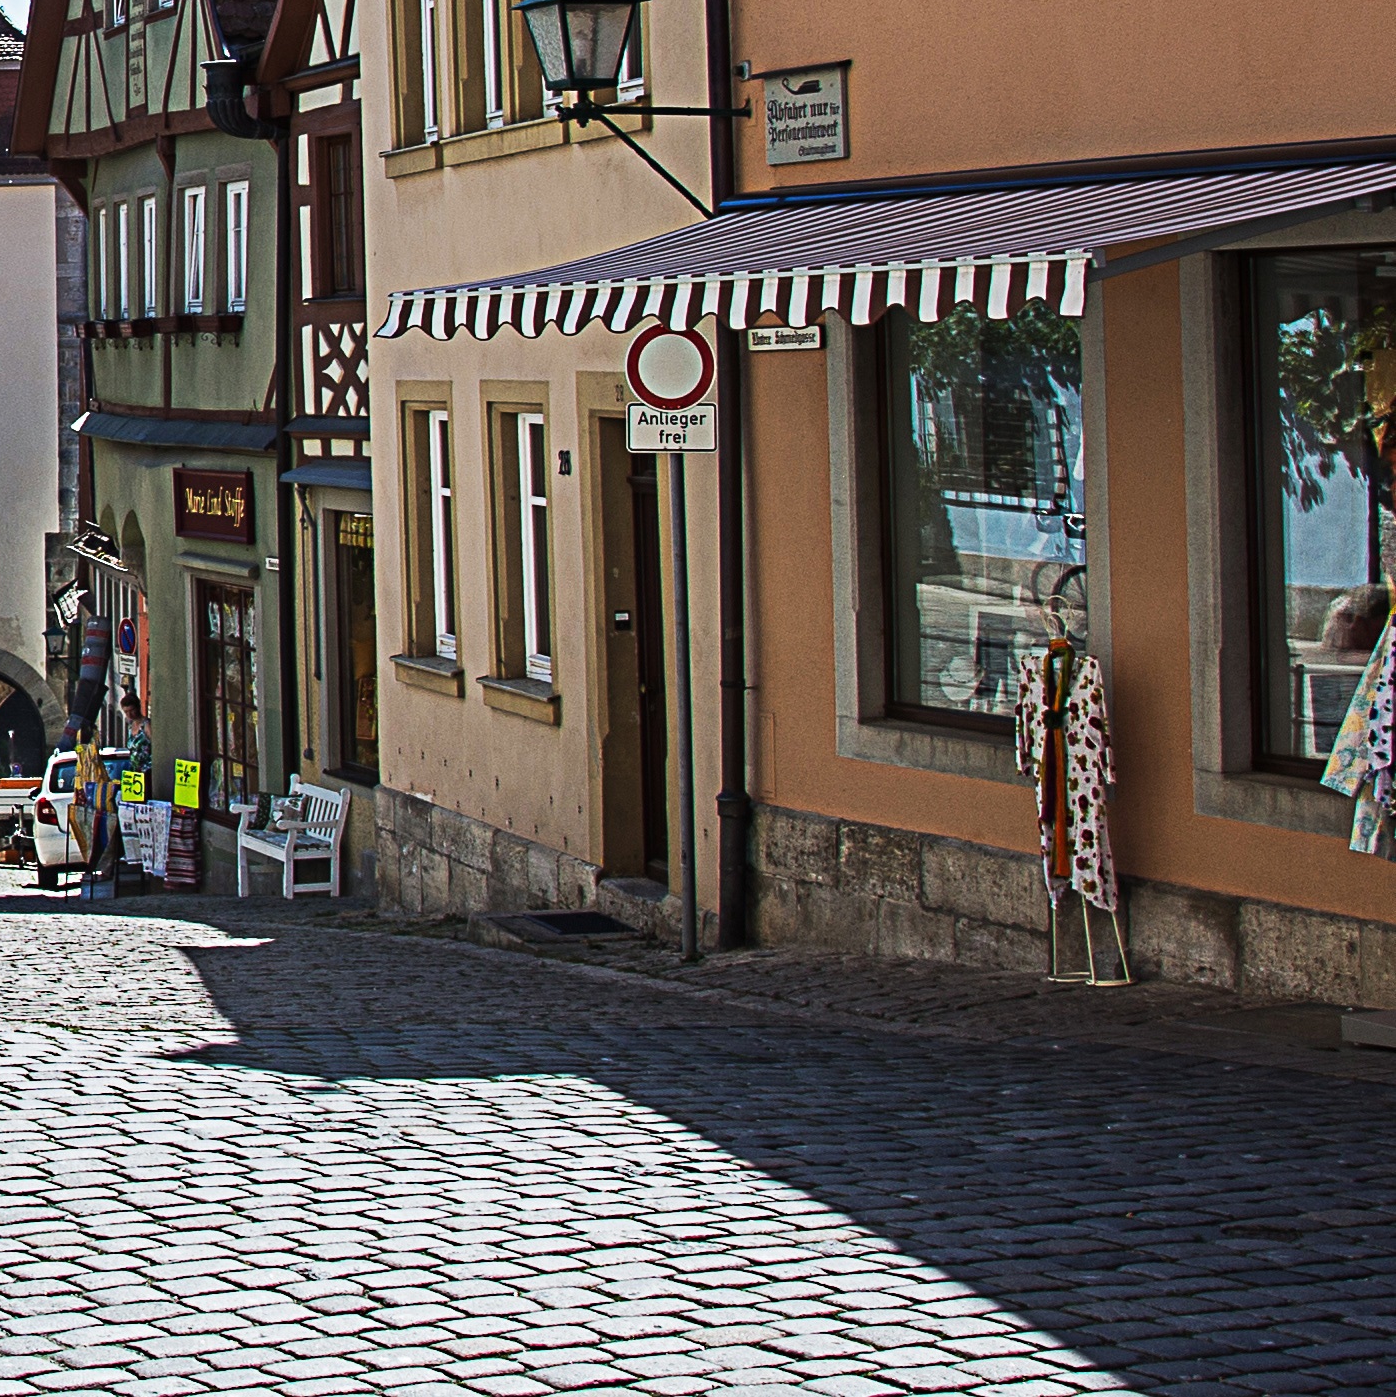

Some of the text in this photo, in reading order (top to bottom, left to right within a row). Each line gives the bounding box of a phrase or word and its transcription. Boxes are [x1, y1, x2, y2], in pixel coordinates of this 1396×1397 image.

[809, 102, 829, 117] nur
[637, 411, 707, 429] Anlieger
[658, 429, 687, 444] frei
